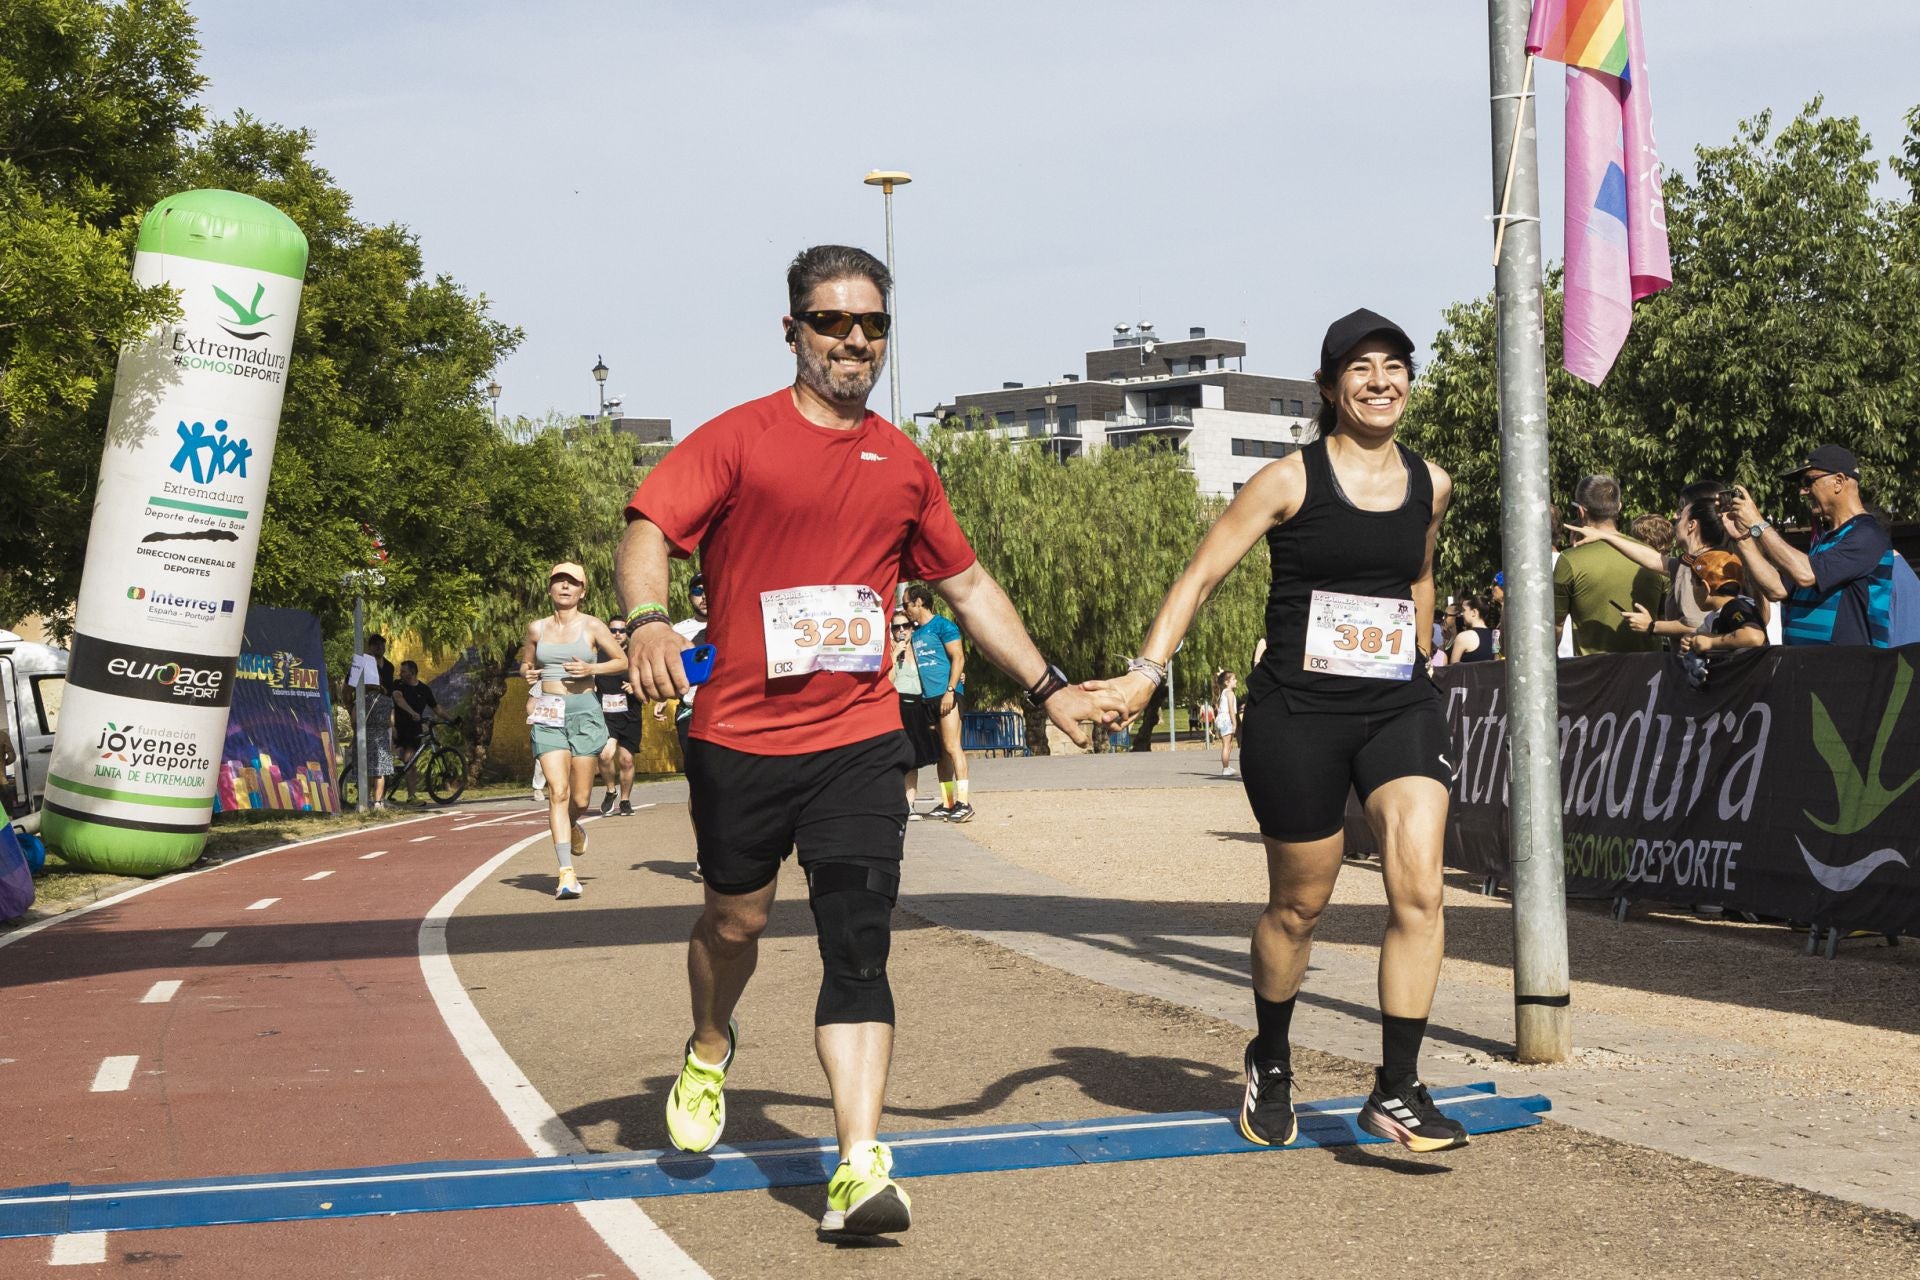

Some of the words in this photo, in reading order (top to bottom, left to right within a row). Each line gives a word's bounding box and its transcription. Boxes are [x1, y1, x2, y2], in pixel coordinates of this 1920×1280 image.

[173, 332, 285, 369] Extremadura
[174, 354, 281, 383] #SOMOSDEPORTE
[163, 481, 244, 504] Extremadura
[144, 507, 184, 522] Deporte
[187, 515, 216, 527] desde
[218, 520, 226, 528] la
[229, 521, 245, 530] Base
[136, 547, 186, 561] DIRECCION
[187, 556, 225, 567] GENERAL
[163, 563, 211, 577] DEPORTES
[150, 590, 218, 613] Interreg
[148, 606, 178, 616] España
[185, 611, 216, 621] Portugal
[794, 617, 871, 648] 320
[1333, 624, 1403, 655] 381
[107, 658, 223, 687] euroace
[173, 685, 219, 699] SPORT
[138, 725, 196, 740] fundación
[130, 752, 209, 771] ydeporte
[94, 764, 121, 779] JUNTA
[127, 769, 141, 782] DE
[145, 772, 205, 787] EXTREMADURA
